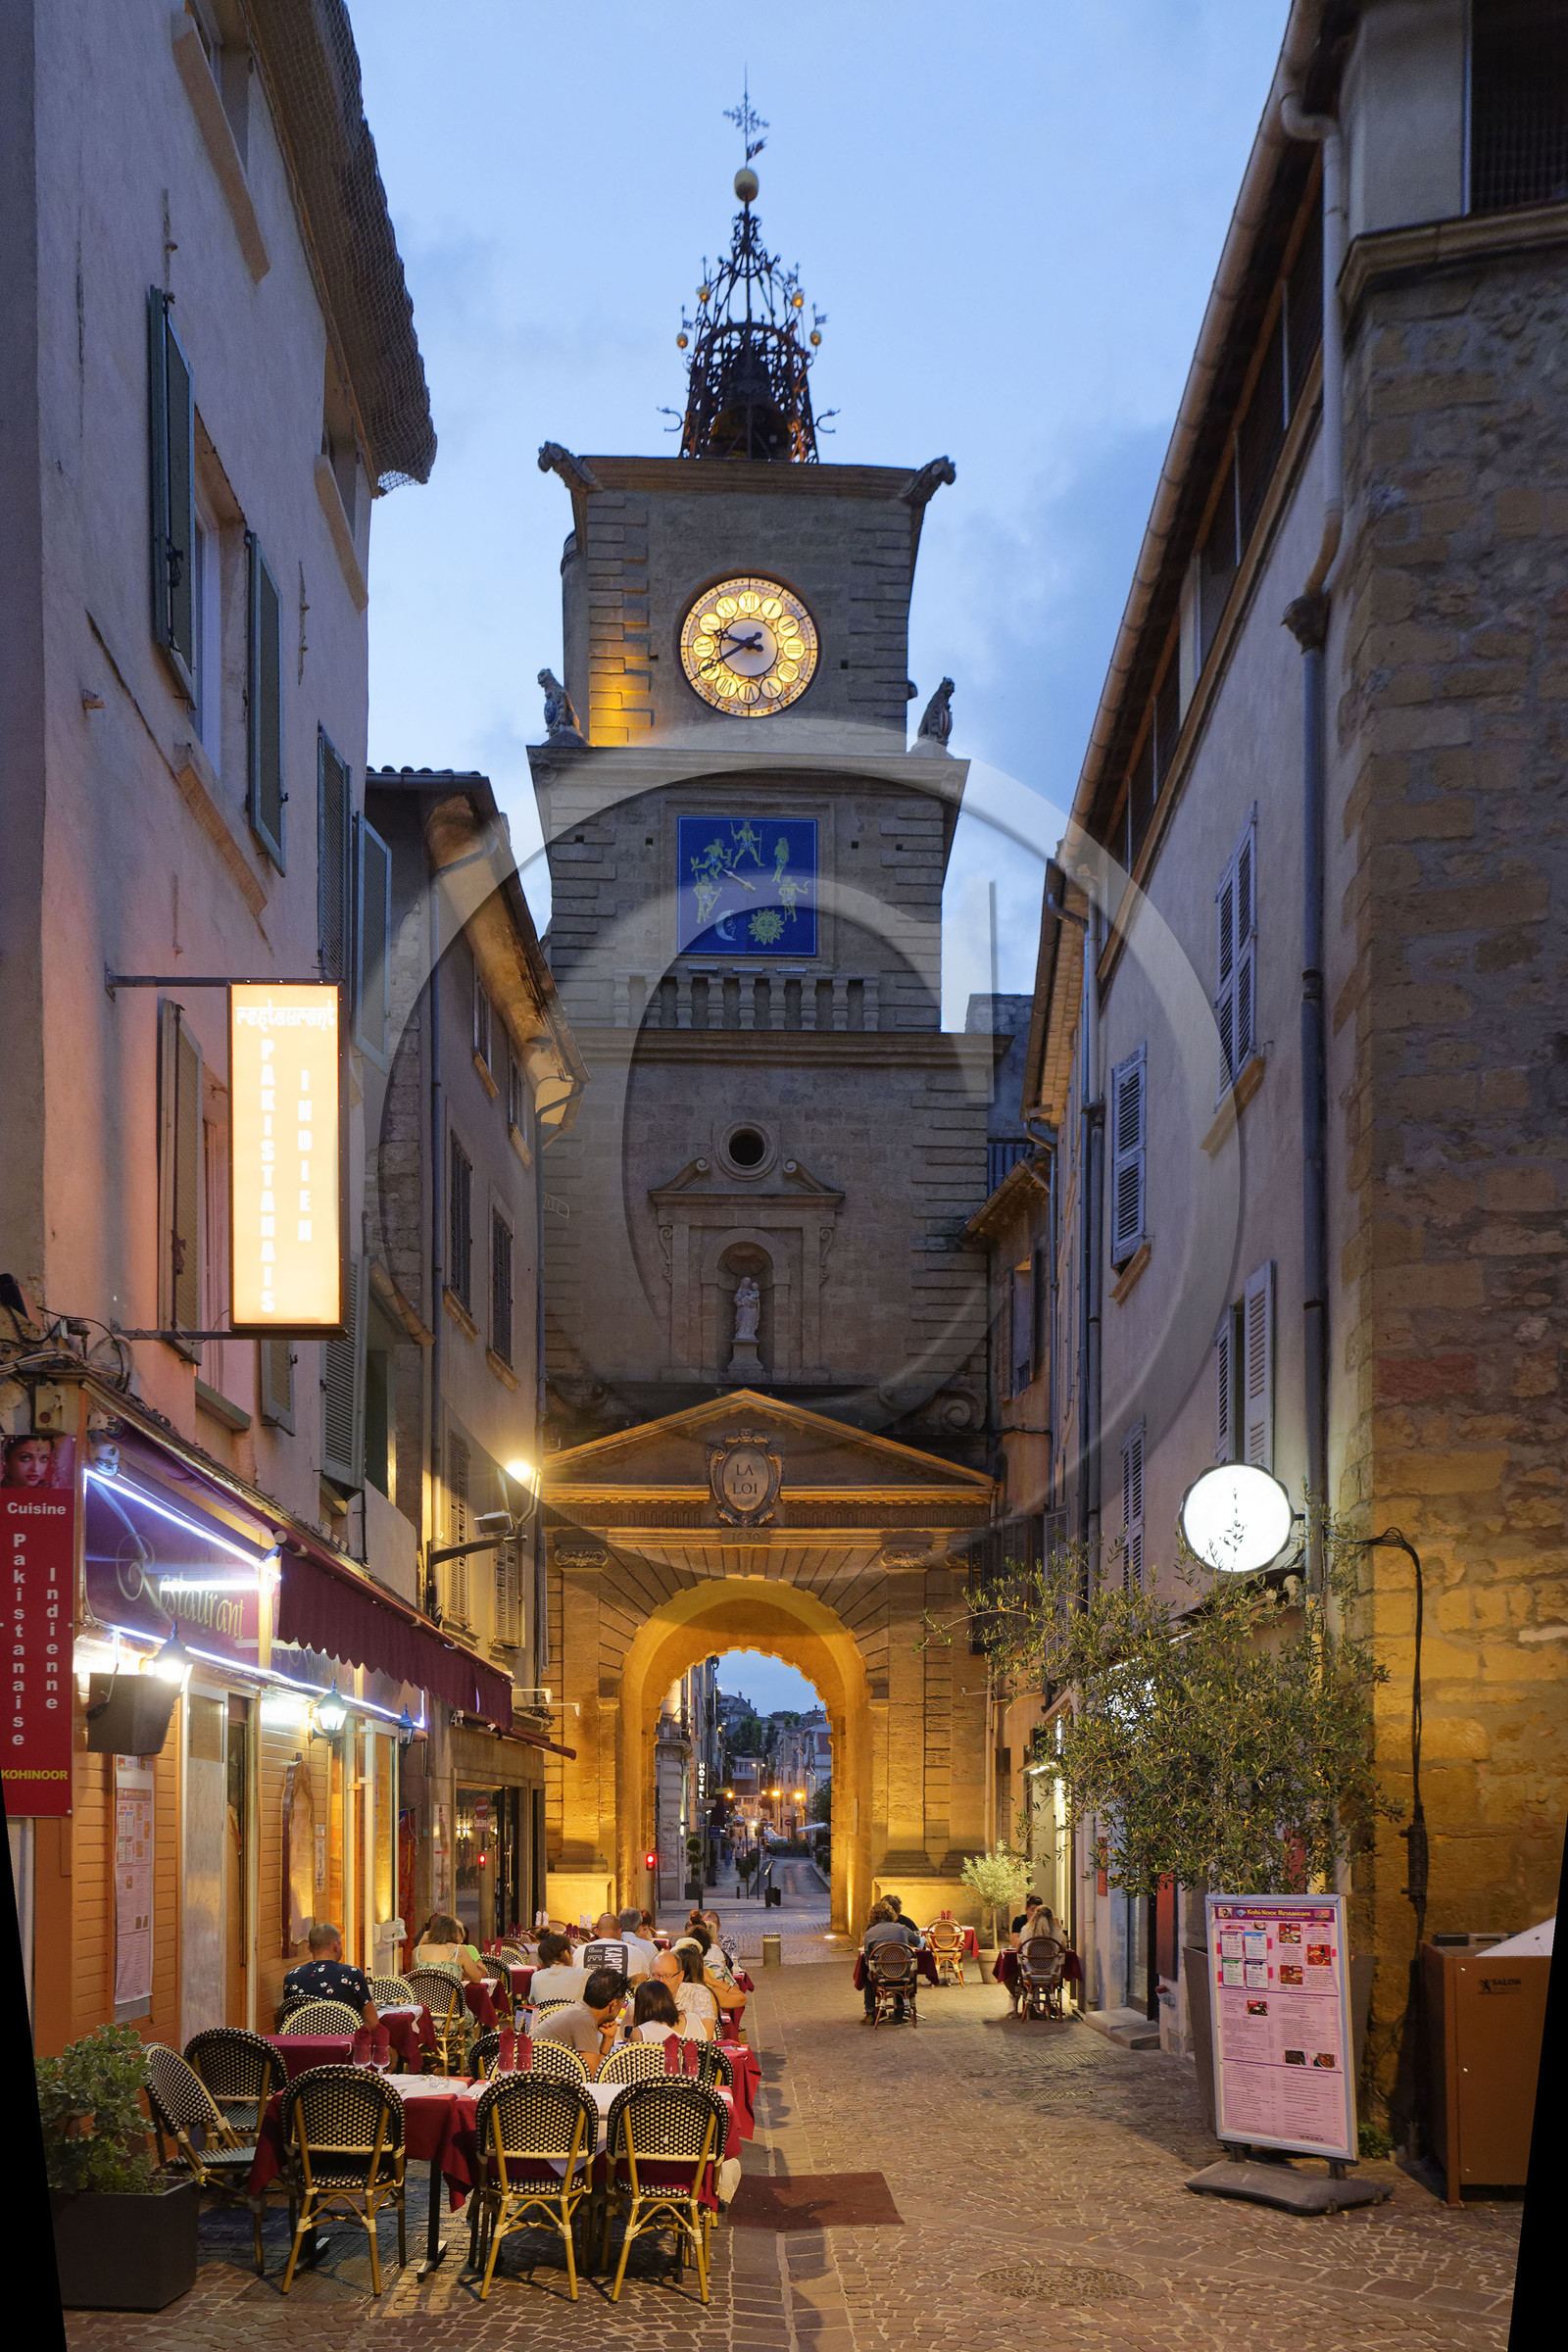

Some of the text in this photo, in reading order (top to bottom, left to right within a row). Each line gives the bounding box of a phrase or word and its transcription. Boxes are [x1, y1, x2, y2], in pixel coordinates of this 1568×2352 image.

[235, 999, 336, 1033] restaurant
[297, 1069, 313, 1242] INDIEN
[260, 1039, 276, 1313] PAKISTANAIS
[736, 1464, 754, 1476] LA
[733, 1483, 758, 1494] LOI
[6, 1501, 67, 1515] Cuisine
[732, 1532, 760, 1543] 1630
[116, 1534, 245, 1641] Restaurant
[12, 1534, 26, 1745] Pakistanaise
[45, 1567, 60, 1709] Indienne
[1, 1769, 69, 1781] KOHINOOR
[1492, 1978, 1521, 1986] SALON
